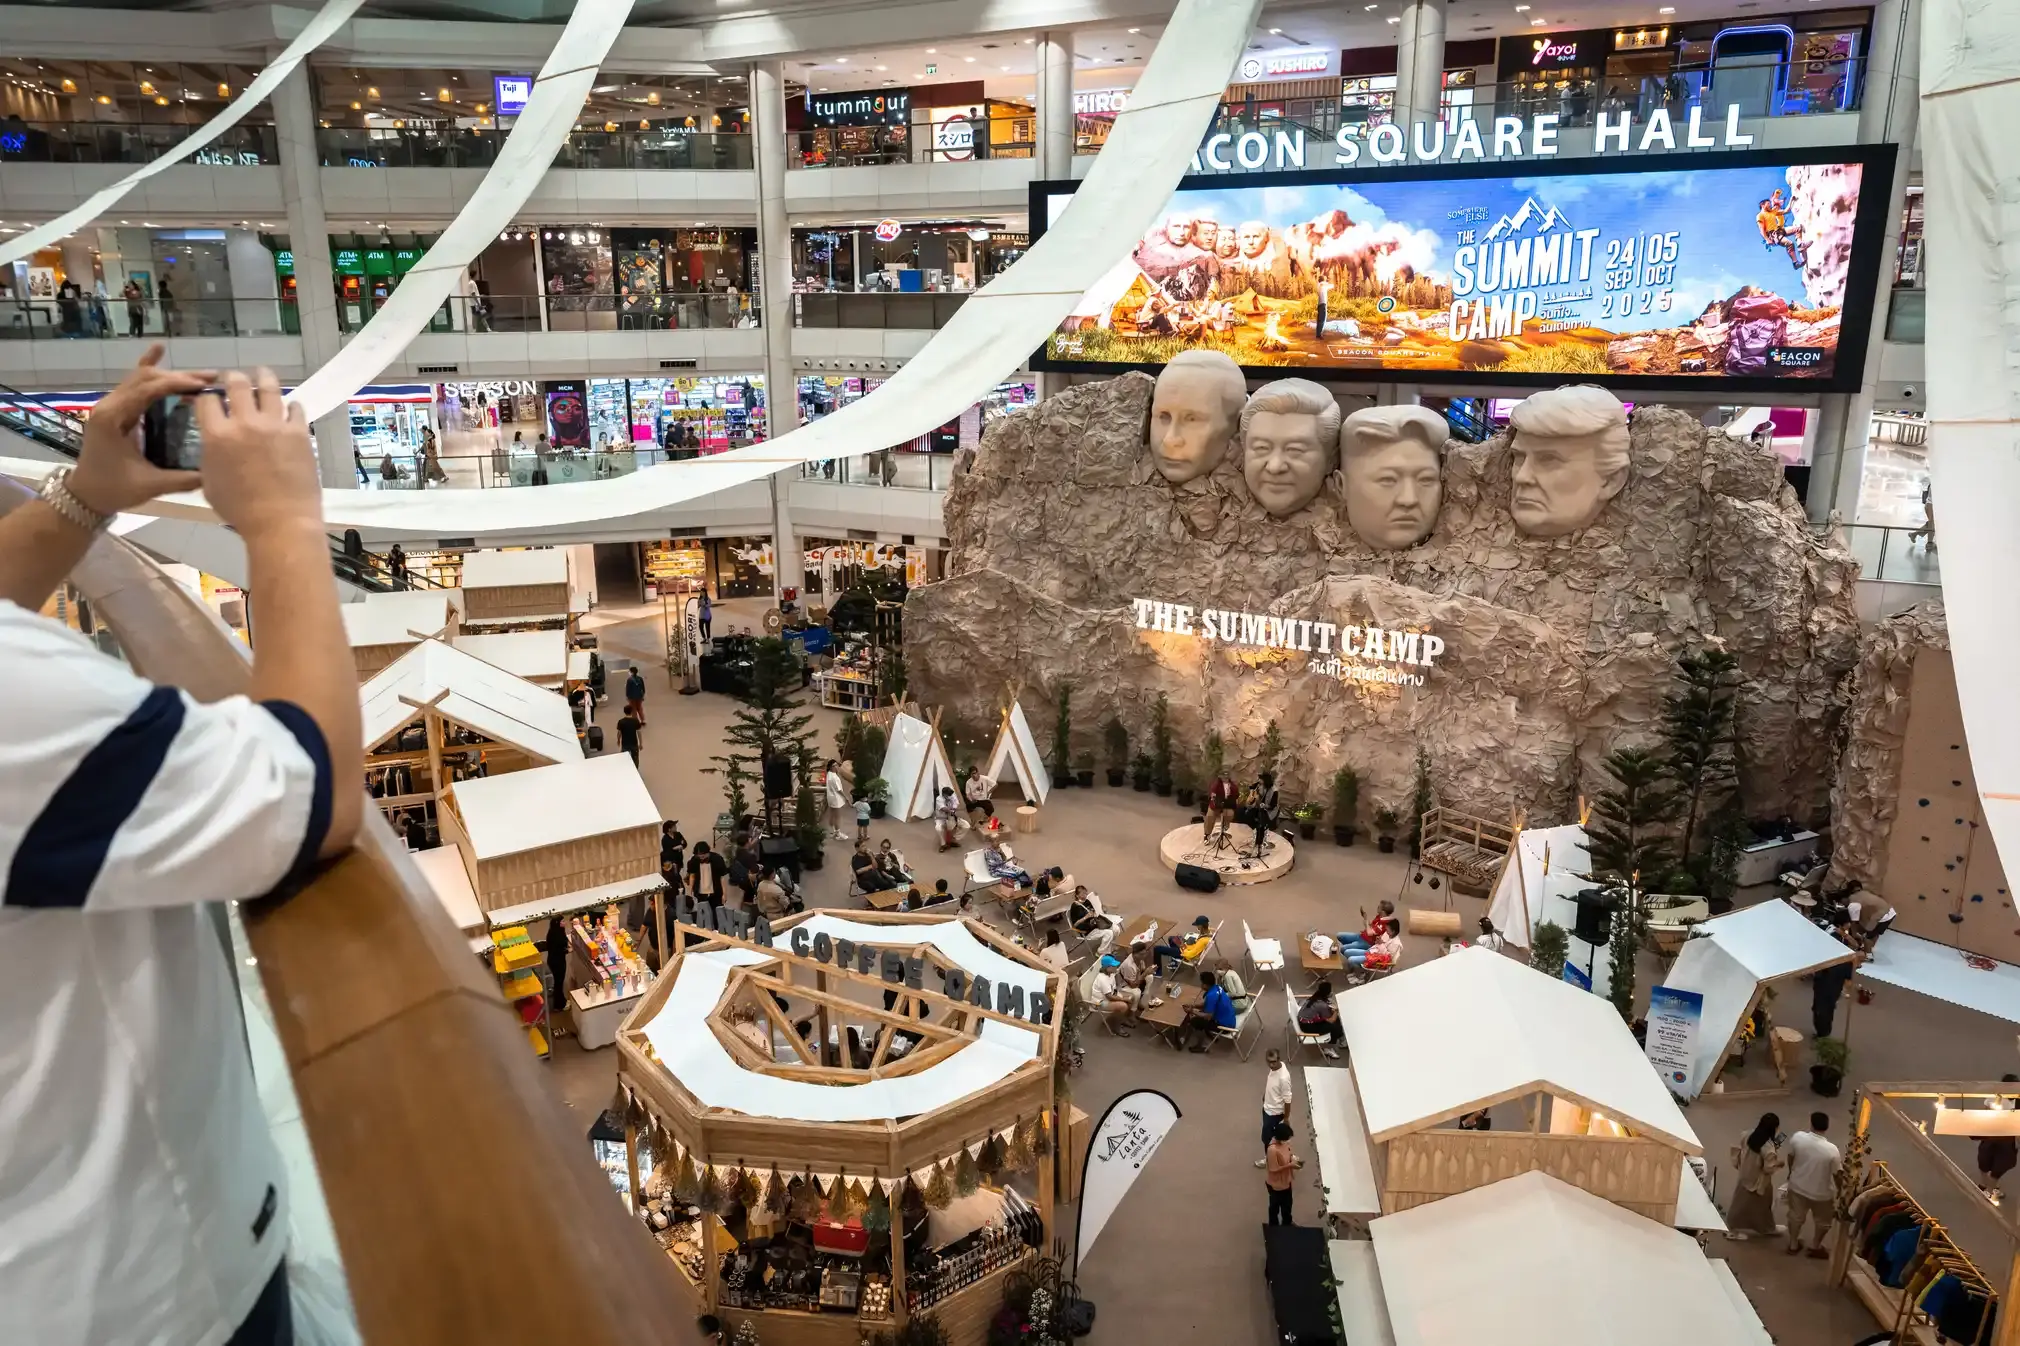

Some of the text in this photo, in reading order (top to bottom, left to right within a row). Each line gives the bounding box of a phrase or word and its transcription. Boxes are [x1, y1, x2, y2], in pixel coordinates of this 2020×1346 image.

[1267, 55, 1328, 74] SUSHIRO
[1073, 92, 1128, 114] HIRO
[1335, 114, 1561, 164] SQUARE
[1594, 102, 1755, 154] HALL
[881, 224, 898, 236] DQ
[1457, 229, 1476, 246] THE
[1452, 228, 1600, 296] SUMMIT
[1606, 231, 1680, 270] 24 05
[1604, 263, 1676, 291] SEP OCT
[1450, 290, 1538, 342] CAMP
[1601, 287, 1673, 319] 2025
[445, 381, 537, 398] SEASON
[1133, 598, 1445, 667] THE SUMMIT CAMP
[790, 927, 925, 990] COFFEE
[1119, 1127, 1147, 1160] Lanta
